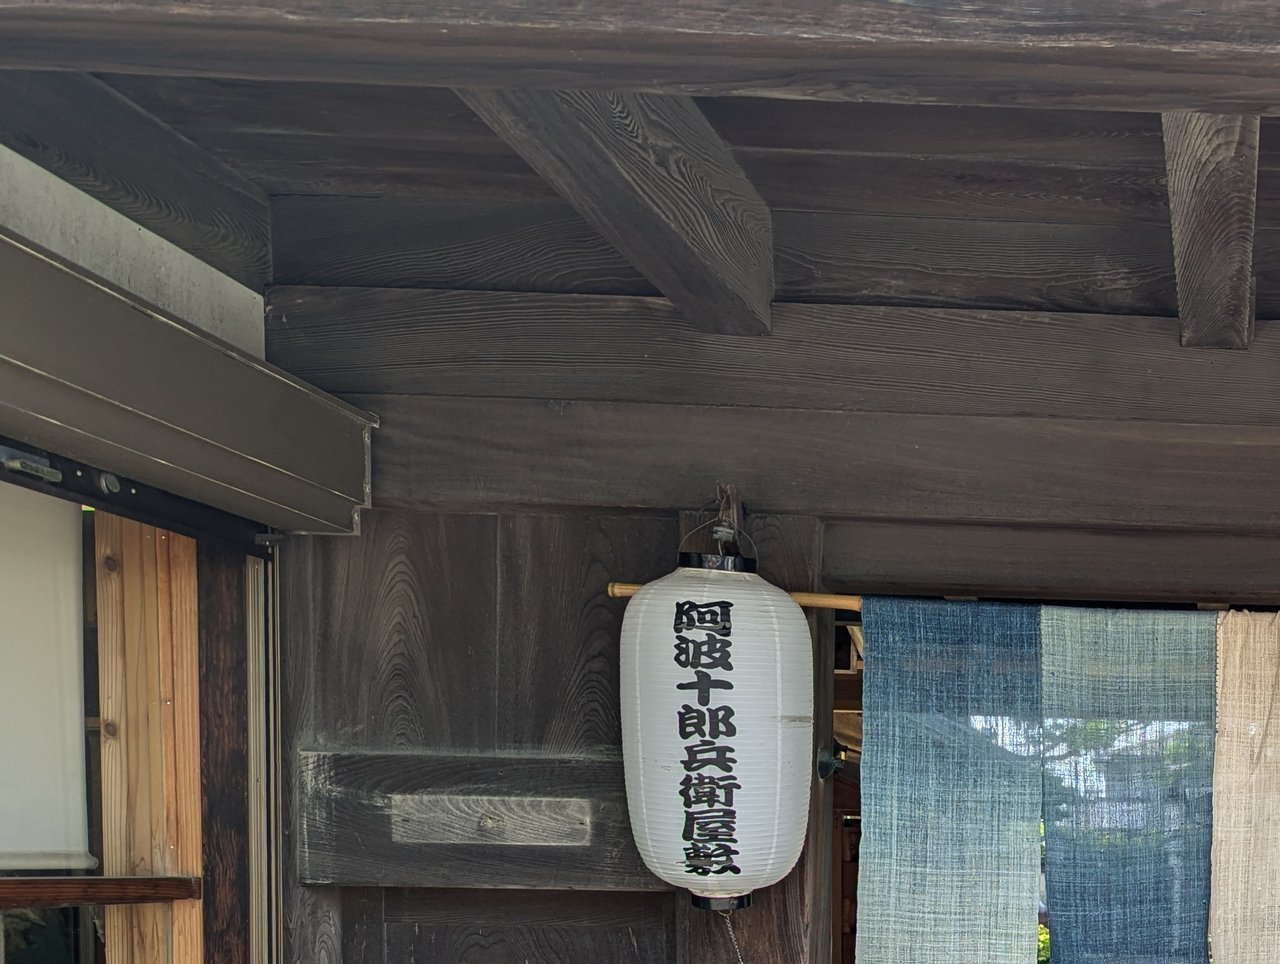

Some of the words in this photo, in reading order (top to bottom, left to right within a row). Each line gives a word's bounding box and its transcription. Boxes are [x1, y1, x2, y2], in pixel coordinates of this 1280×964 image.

[673, 600, 742, 876] 阿波十郎兵衛屋敷
